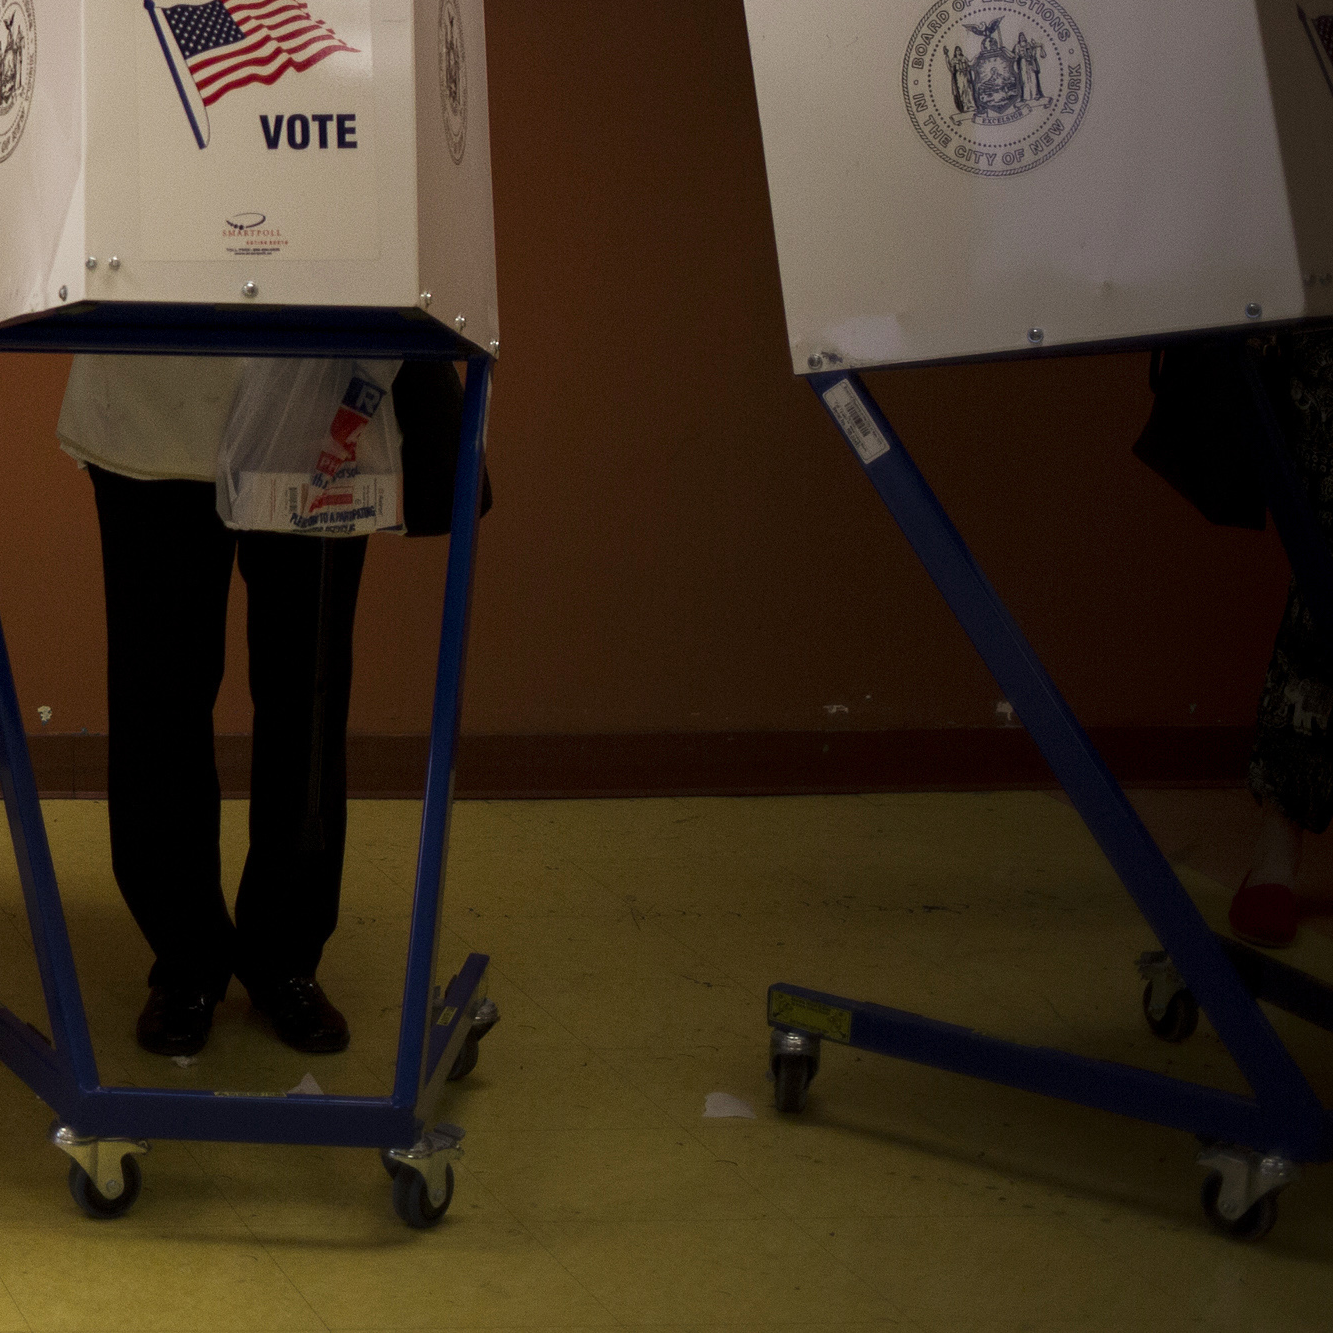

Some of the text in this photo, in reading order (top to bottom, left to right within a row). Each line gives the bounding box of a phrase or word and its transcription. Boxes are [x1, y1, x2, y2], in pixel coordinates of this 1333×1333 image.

[911, 9, 951, 70] BOARD
[259, 113, 358, 151] VOTE
[912, 64, 1082, 167] IN THE CITY OF NEW YORK
